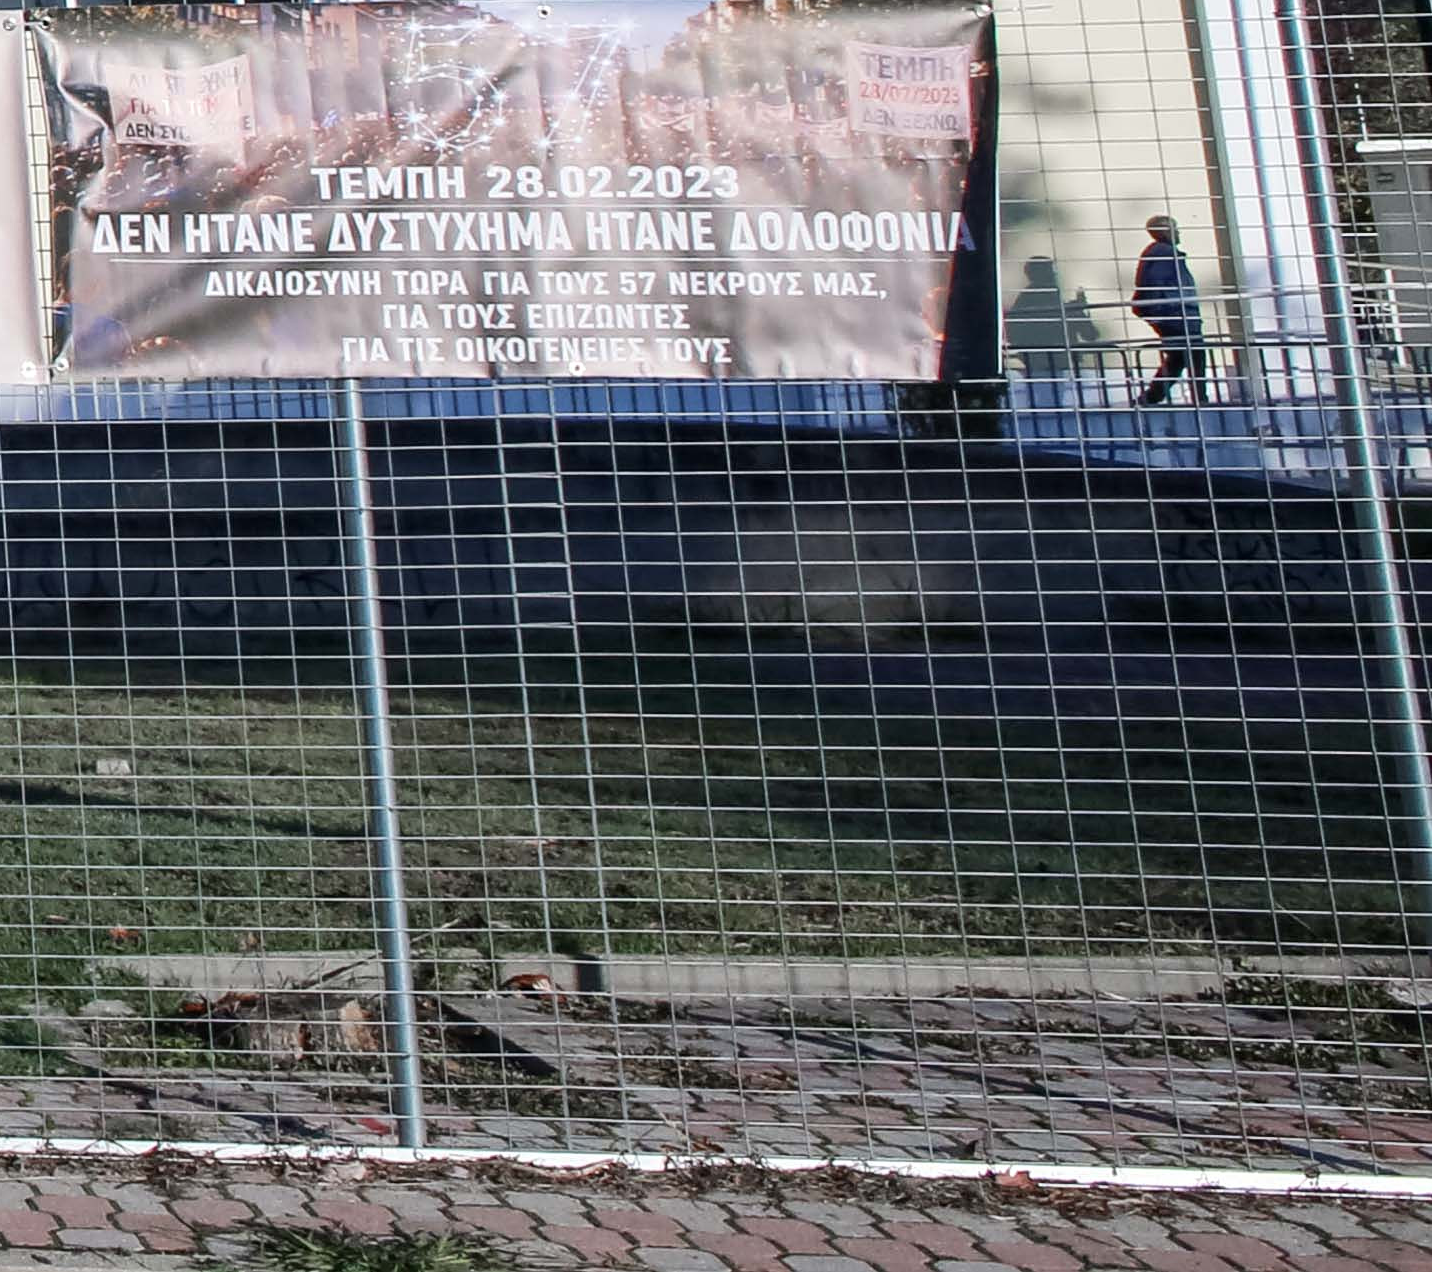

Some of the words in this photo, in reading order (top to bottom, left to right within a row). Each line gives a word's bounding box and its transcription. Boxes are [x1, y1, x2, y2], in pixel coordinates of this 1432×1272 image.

[861, 53, 955, 81] ΤΕΜΠΗ
[311, 166, 467, 202] ΤΕΜΠΗ
[486, 165, 740, 200] 28.02.2023
[92, 215, 175, 253] ΔΕΝ
[184, 214, 313, 253] ΗΤΑΝΕ
[327, 212, 569, 253] ΔΥΣΤΥΧΗΜΑ
[586, 213, 714, 252] ΗΤΑΝΕ
[731, 212, 975, 253] ΔΟΛΟΦΟΝΙΑ
[205, 269, 382, 297] ΔΙΚΑΙΟΣΥΝΗ
[393, 269, 469, 297] ΤΩΡΑ
[484, 270, 530, 296] ΓΙΑ
[538, 270, 611, 296] ΤΟΥΣ
[619, 270, 654, 296] 57
[668, 270, 804, 296] ΝΕΚΡΟΥΣ
[814, 270, 887, 300] ΜΑΣ,
[382, 304, 430, 329] ΓΙΑ
[438, 304, 516, 329] ΤΟΥΣ
[528, 304, 689, 329] ΕΠΙΖΩΝΤΕΣ
[342, 337, 393, 363] ΓΙΑ
[399, 337, 447, 363] ΤΙΣ
[457, 337, 644, 363] ΟΙΚΟΓΕΝΕΙΕΣ
[652, 337, 732, 363] ΤΟΥΣ
